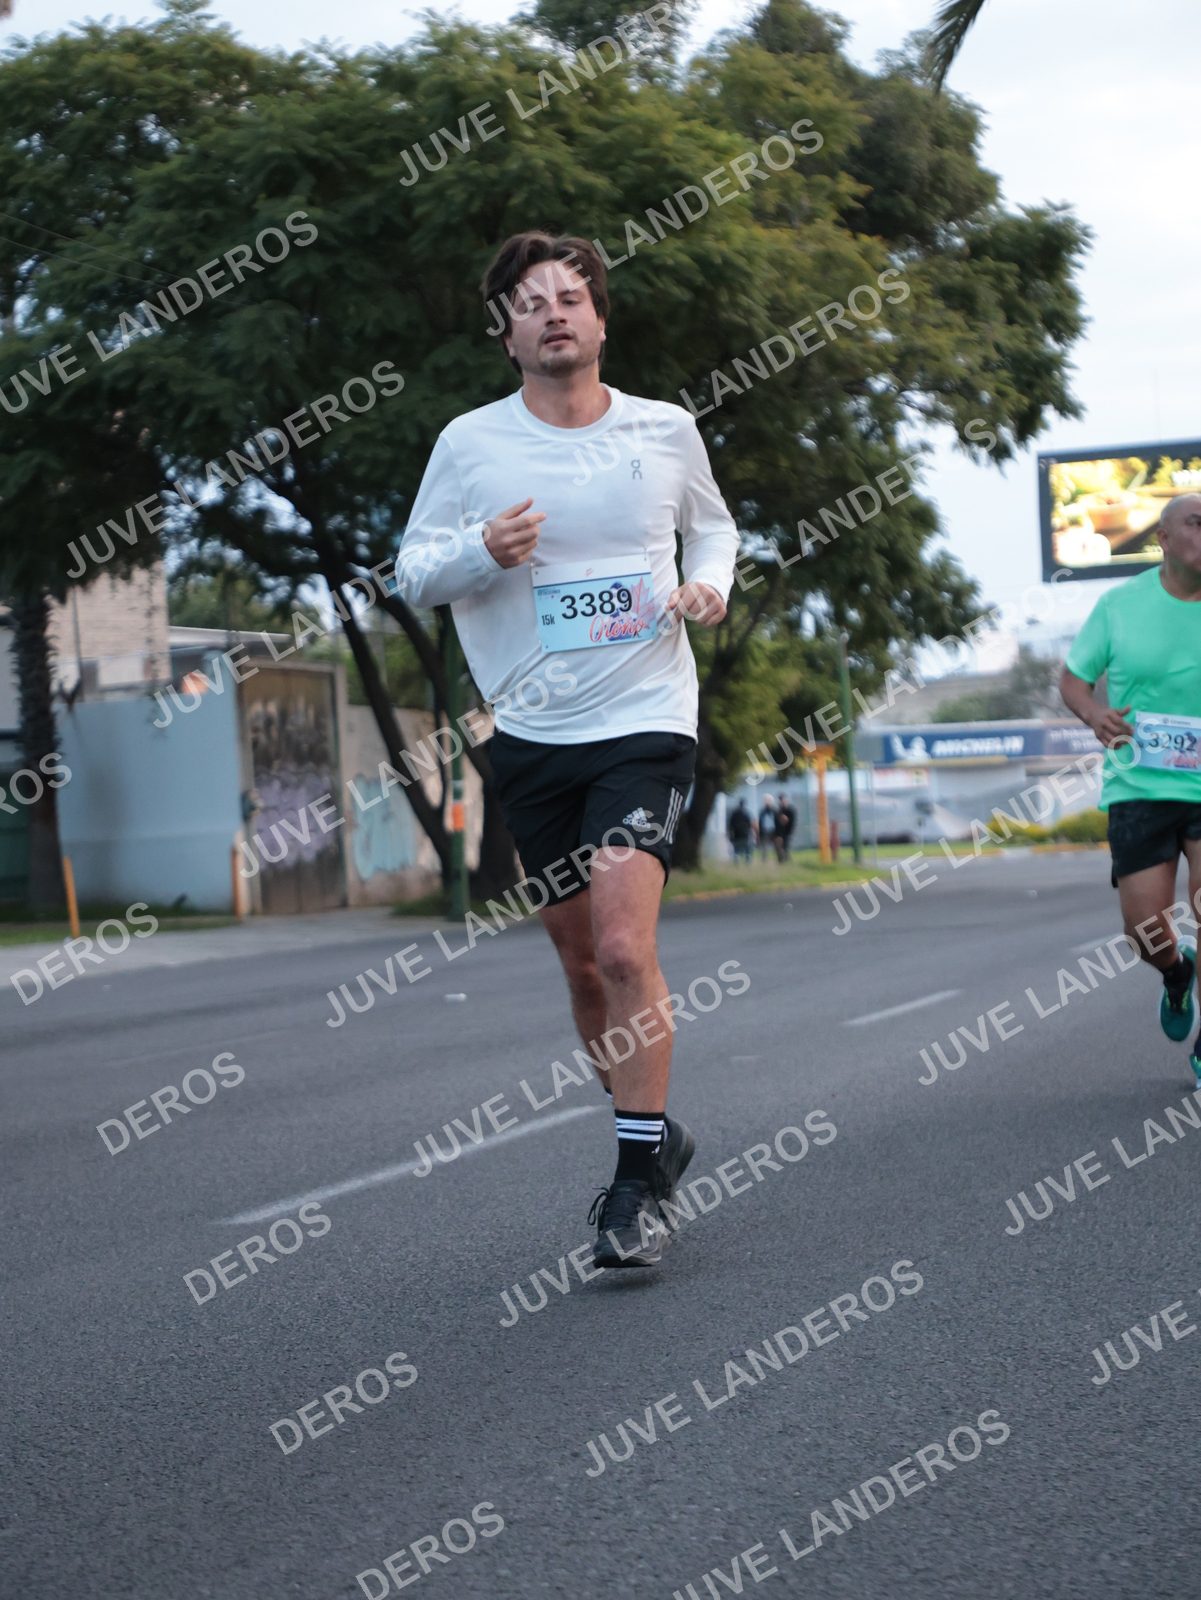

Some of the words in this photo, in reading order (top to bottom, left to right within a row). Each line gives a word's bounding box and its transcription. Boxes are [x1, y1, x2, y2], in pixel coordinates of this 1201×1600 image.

[560, 588, 633, 619] 3389
[541, 614, 555, 626] 15k
[1148, 732, 1197, 751] 3292
